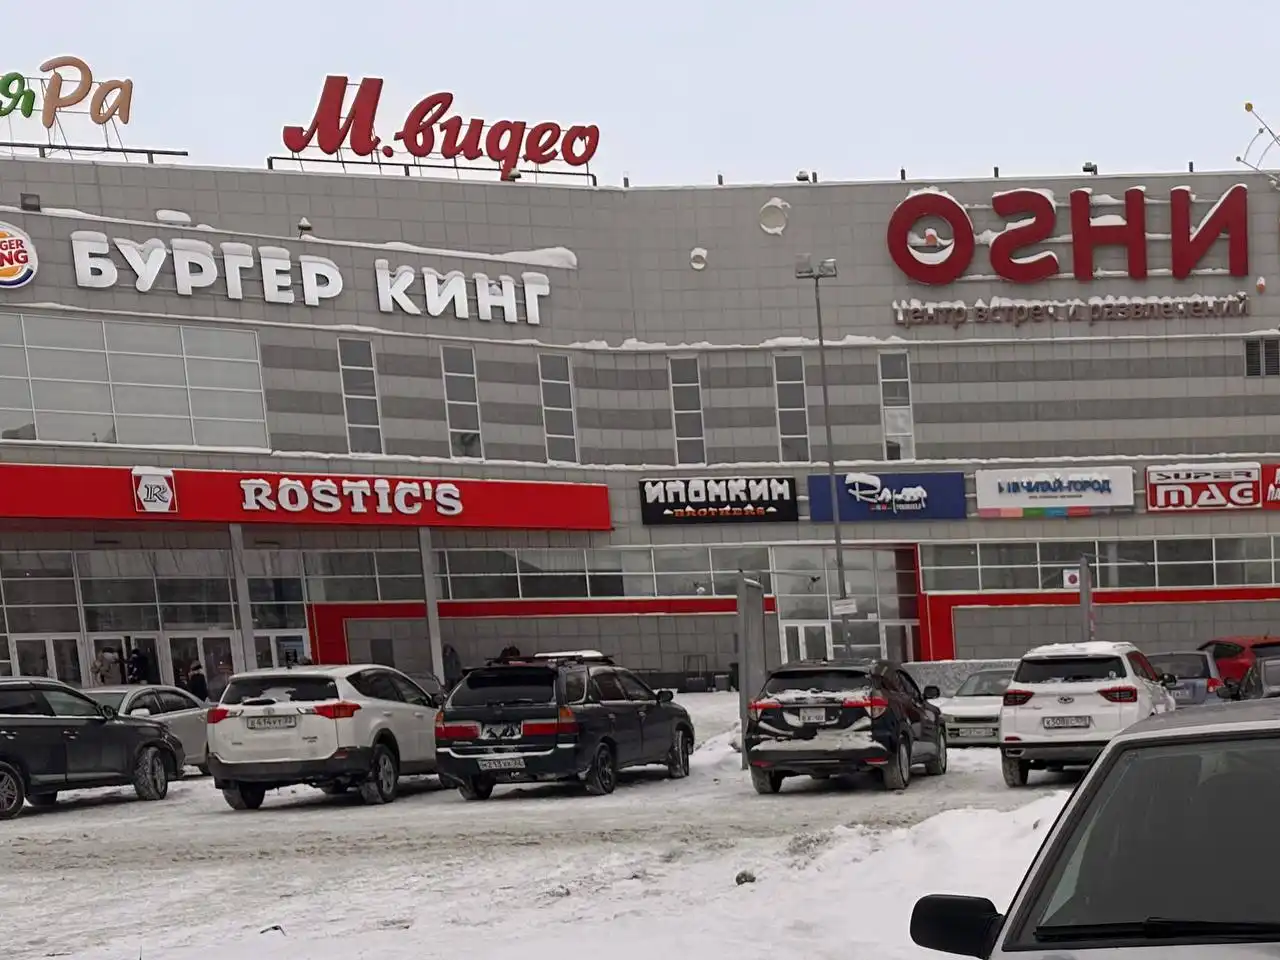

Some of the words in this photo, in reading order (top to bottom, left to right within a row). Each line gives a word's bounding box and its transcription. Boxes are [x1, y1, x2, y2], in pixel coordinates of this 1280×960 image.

[283, 75, 600, 181] М.видео
[71, 230, 343, 306] БУРГЕР
[375, 258, 550, 324] КИНГ
[1157, 470, 1253, 481] SUPER
[240, 478, 463, 516] ROSTIC'S
[1156, 482, 1255, 508] MAG
